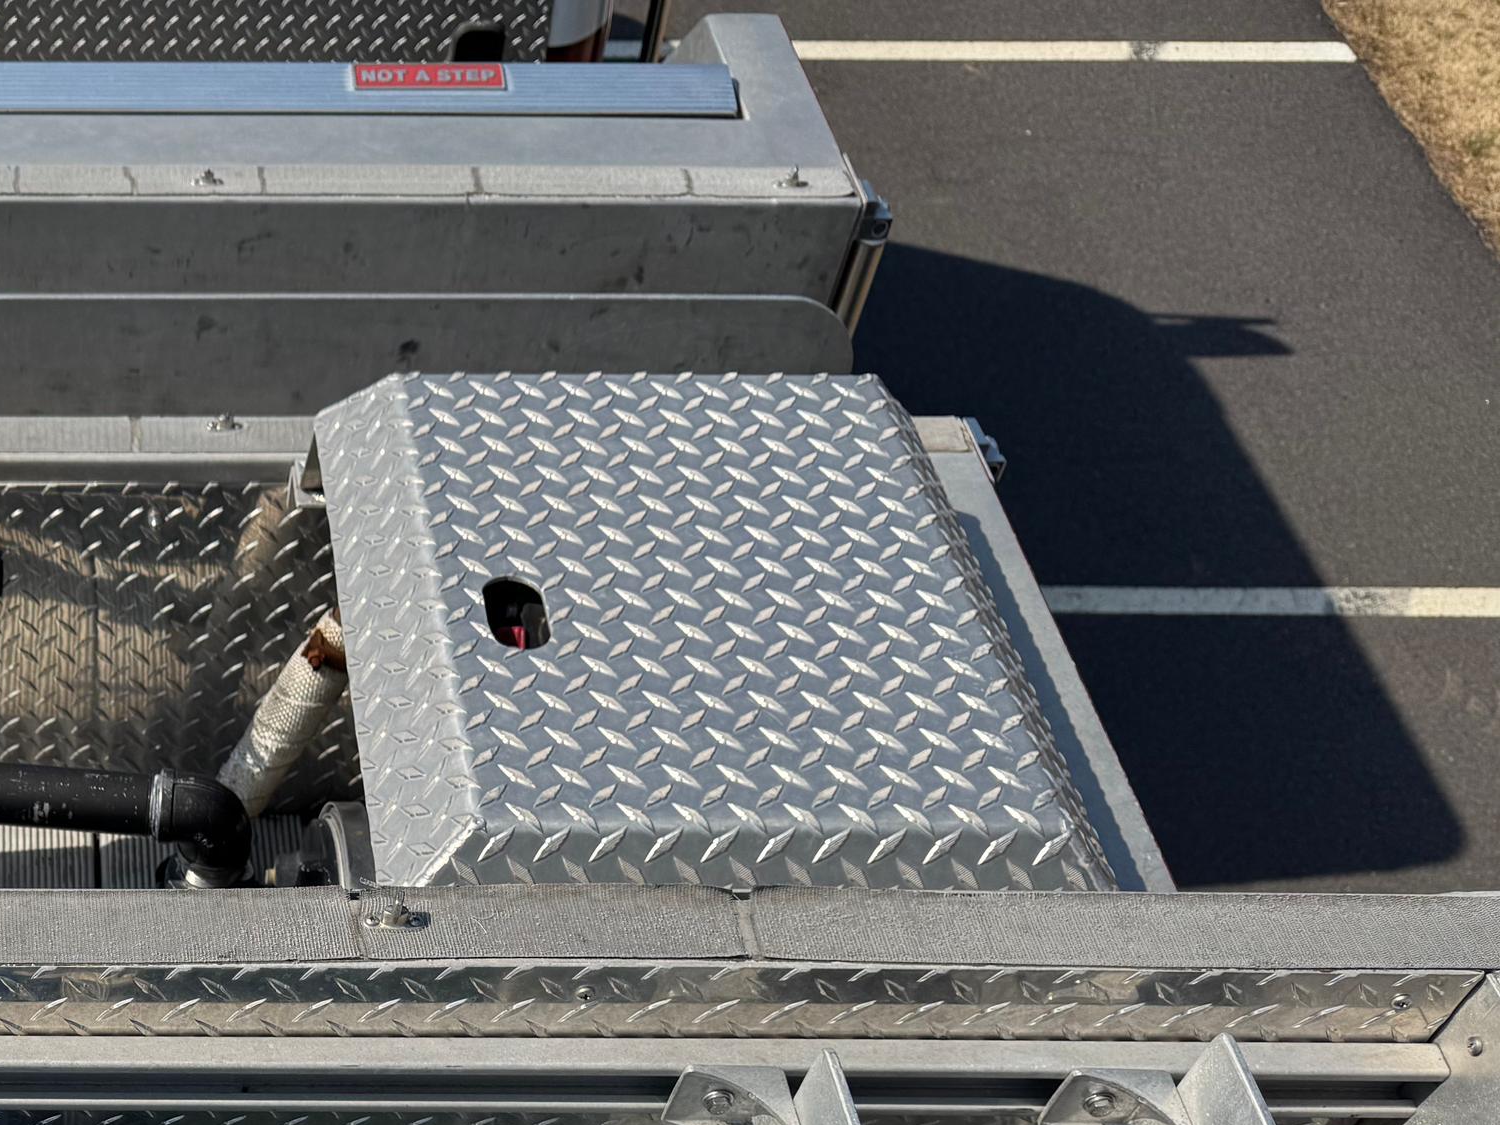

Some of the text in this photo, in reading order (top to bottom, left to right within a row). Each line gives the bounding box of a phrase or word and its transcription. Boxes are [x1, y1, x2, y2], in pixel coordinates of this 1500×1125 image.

[361, 69, 495, 82] NOT A STEP
